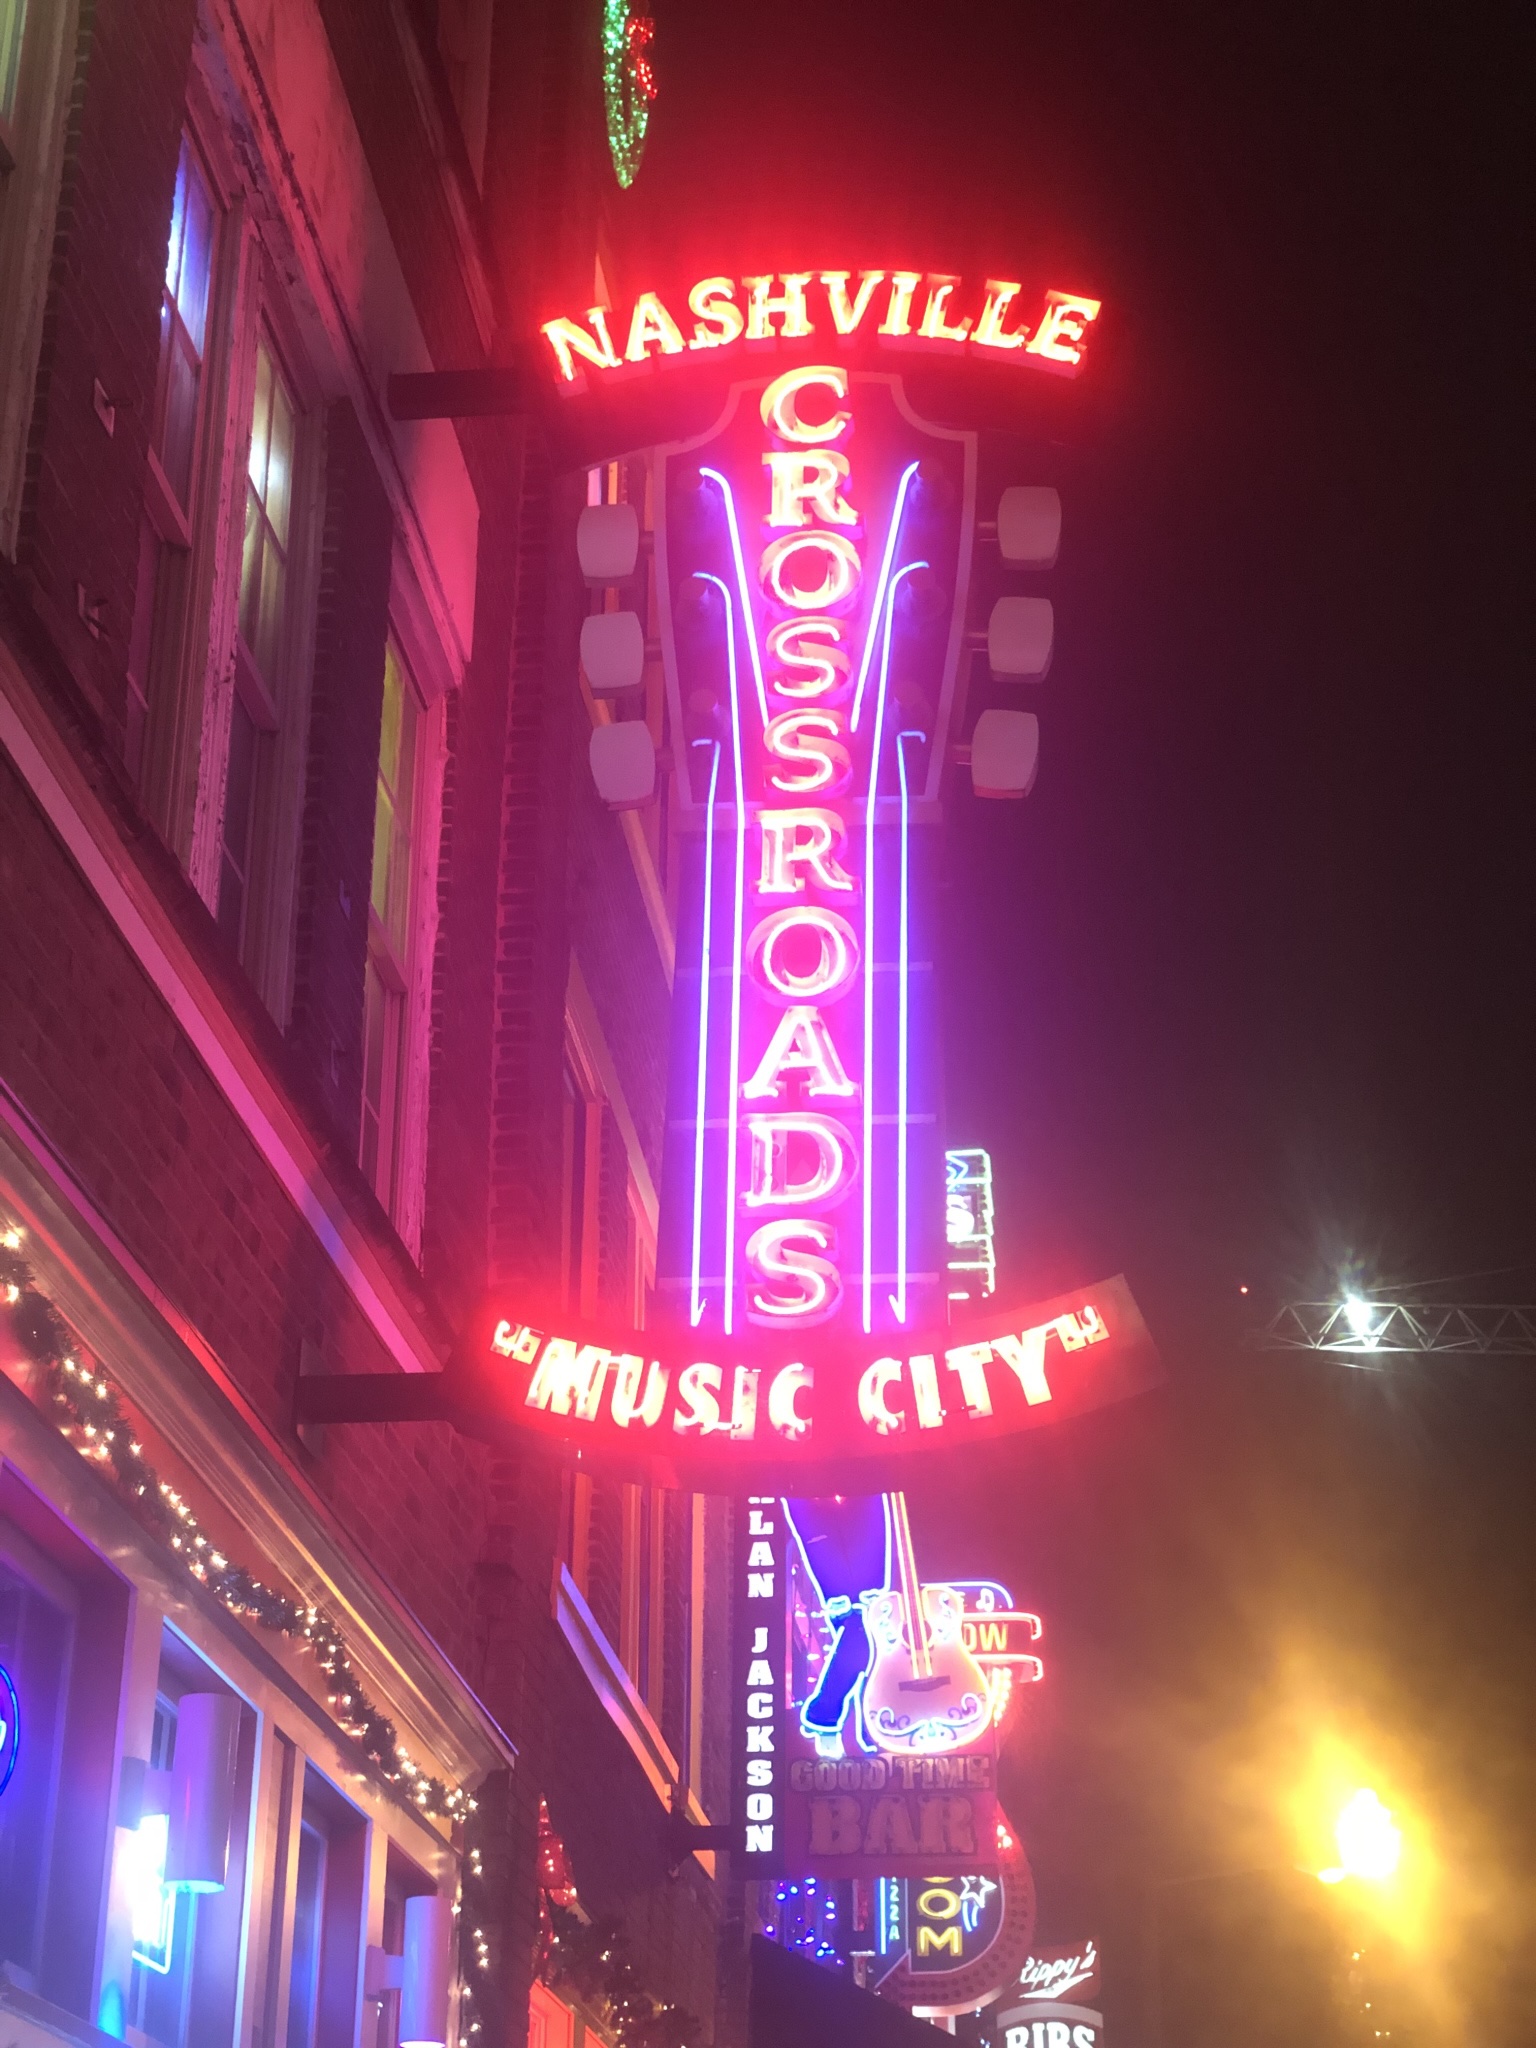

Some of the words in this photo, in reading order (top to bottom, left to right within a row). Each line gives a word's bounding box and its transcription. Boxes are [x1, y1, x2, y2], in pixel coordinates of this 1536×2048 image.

[541, 270, 1102, 382] NASHVILLE
[742, 365, 862, 1327] CROSSROADS
[747, 1497, 775, 1598] LAN
[745, 1627, 775, 1852] JACKSON
[790, 1757, 887, 1792] GOOD
[895, 1757, 991, 1790] TIME
[808, 1796, 976, 1857] BAR
[916, 1876, 963, 1957] OM
